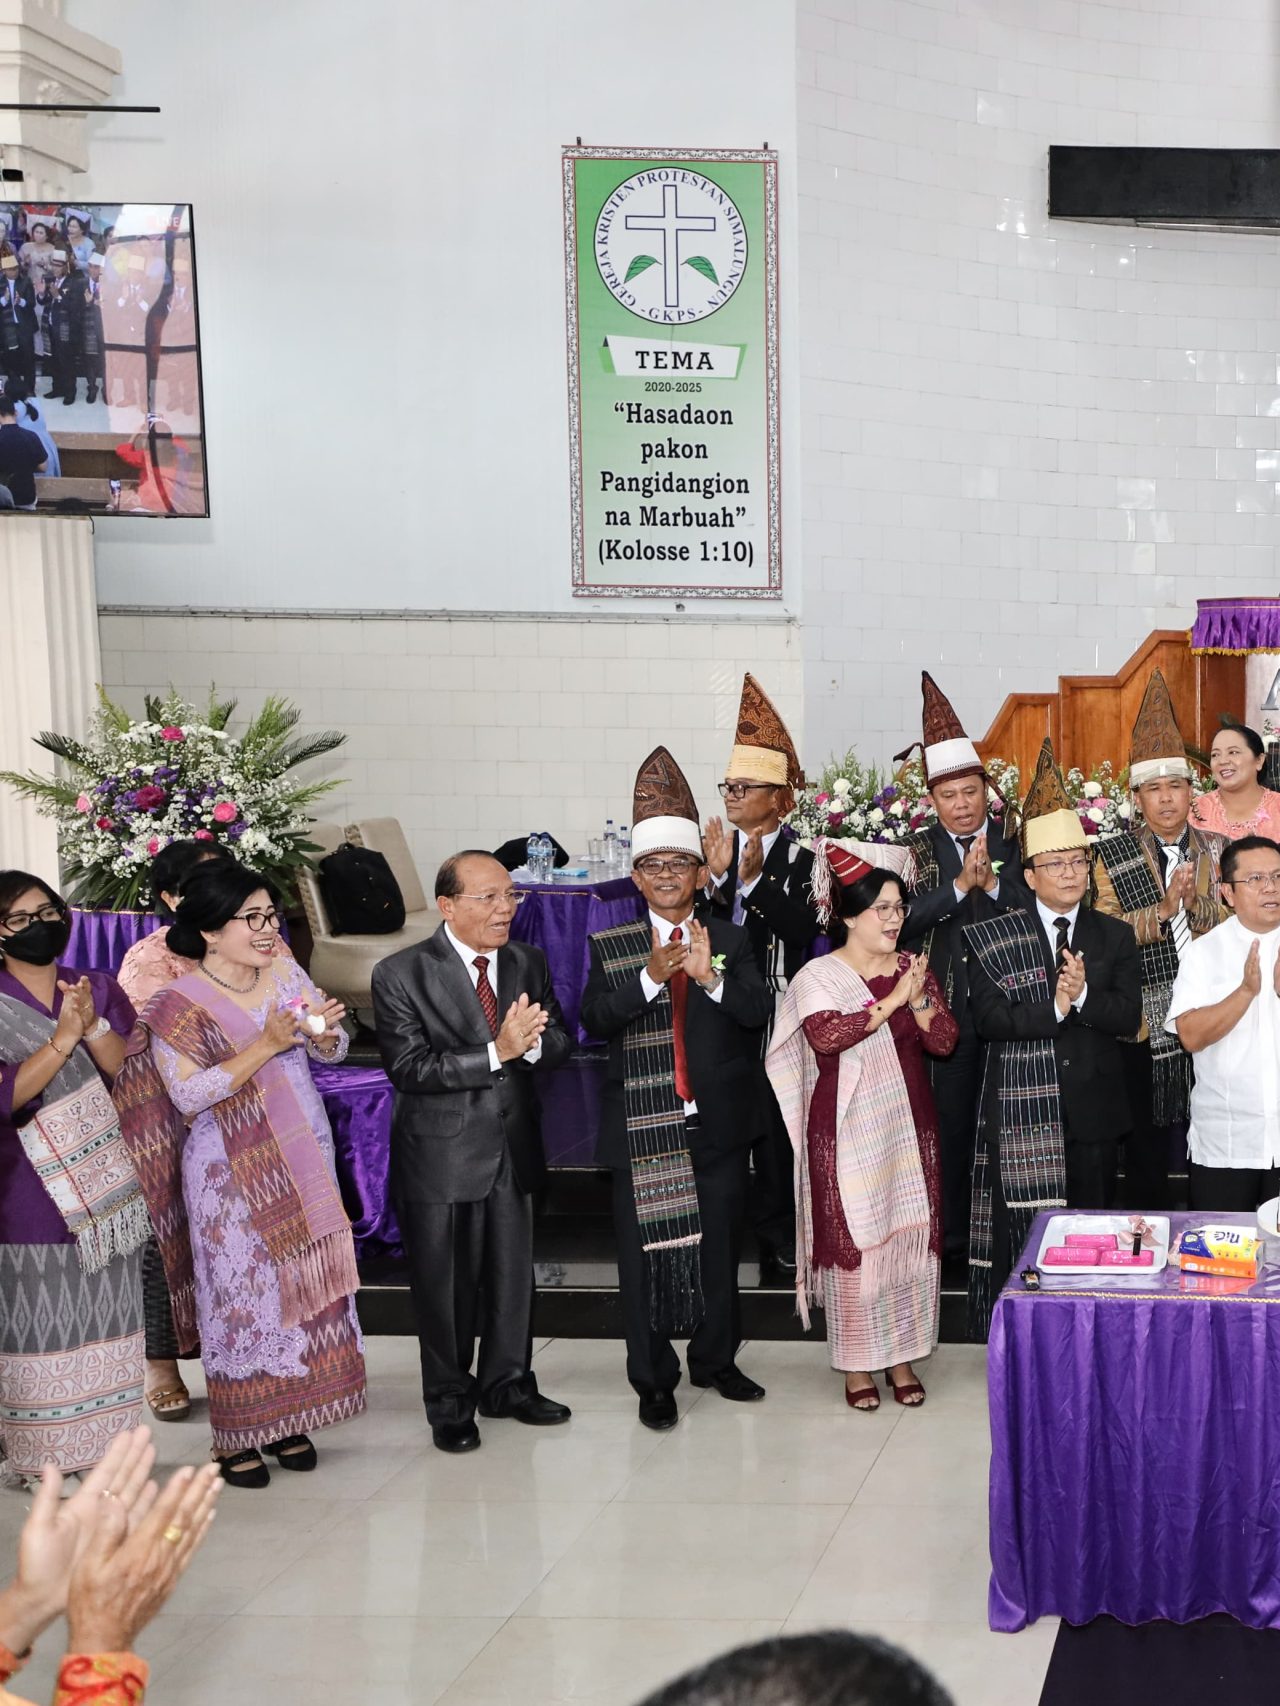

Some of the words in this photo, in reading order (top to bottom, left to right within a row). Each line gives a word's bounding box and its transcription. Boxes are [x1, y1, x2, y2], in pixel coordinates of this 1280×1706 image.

[637, 170, 726, 205] PROTESTAN
[597, 183, 635, 245] KRISTEN
[707, 206, 744, 309] SIMALUNGUN
[598, 250, 636, 308] GEREJA
[636, 351, 714, 370] TEMA
[645, 382, 702, 392] 2020-2025
[614, 403, 733, 424] “Hasadaon
[641, 437, 708, 464] pakon
[601, 471, 749, 499] Pangidangion
[605, 511, 631, 525] na
[640, 506, 745, 527] Marbuah”
[599, 539, 689, 565] (Kolosse
[701, 541, 753, 567] 1:10)
